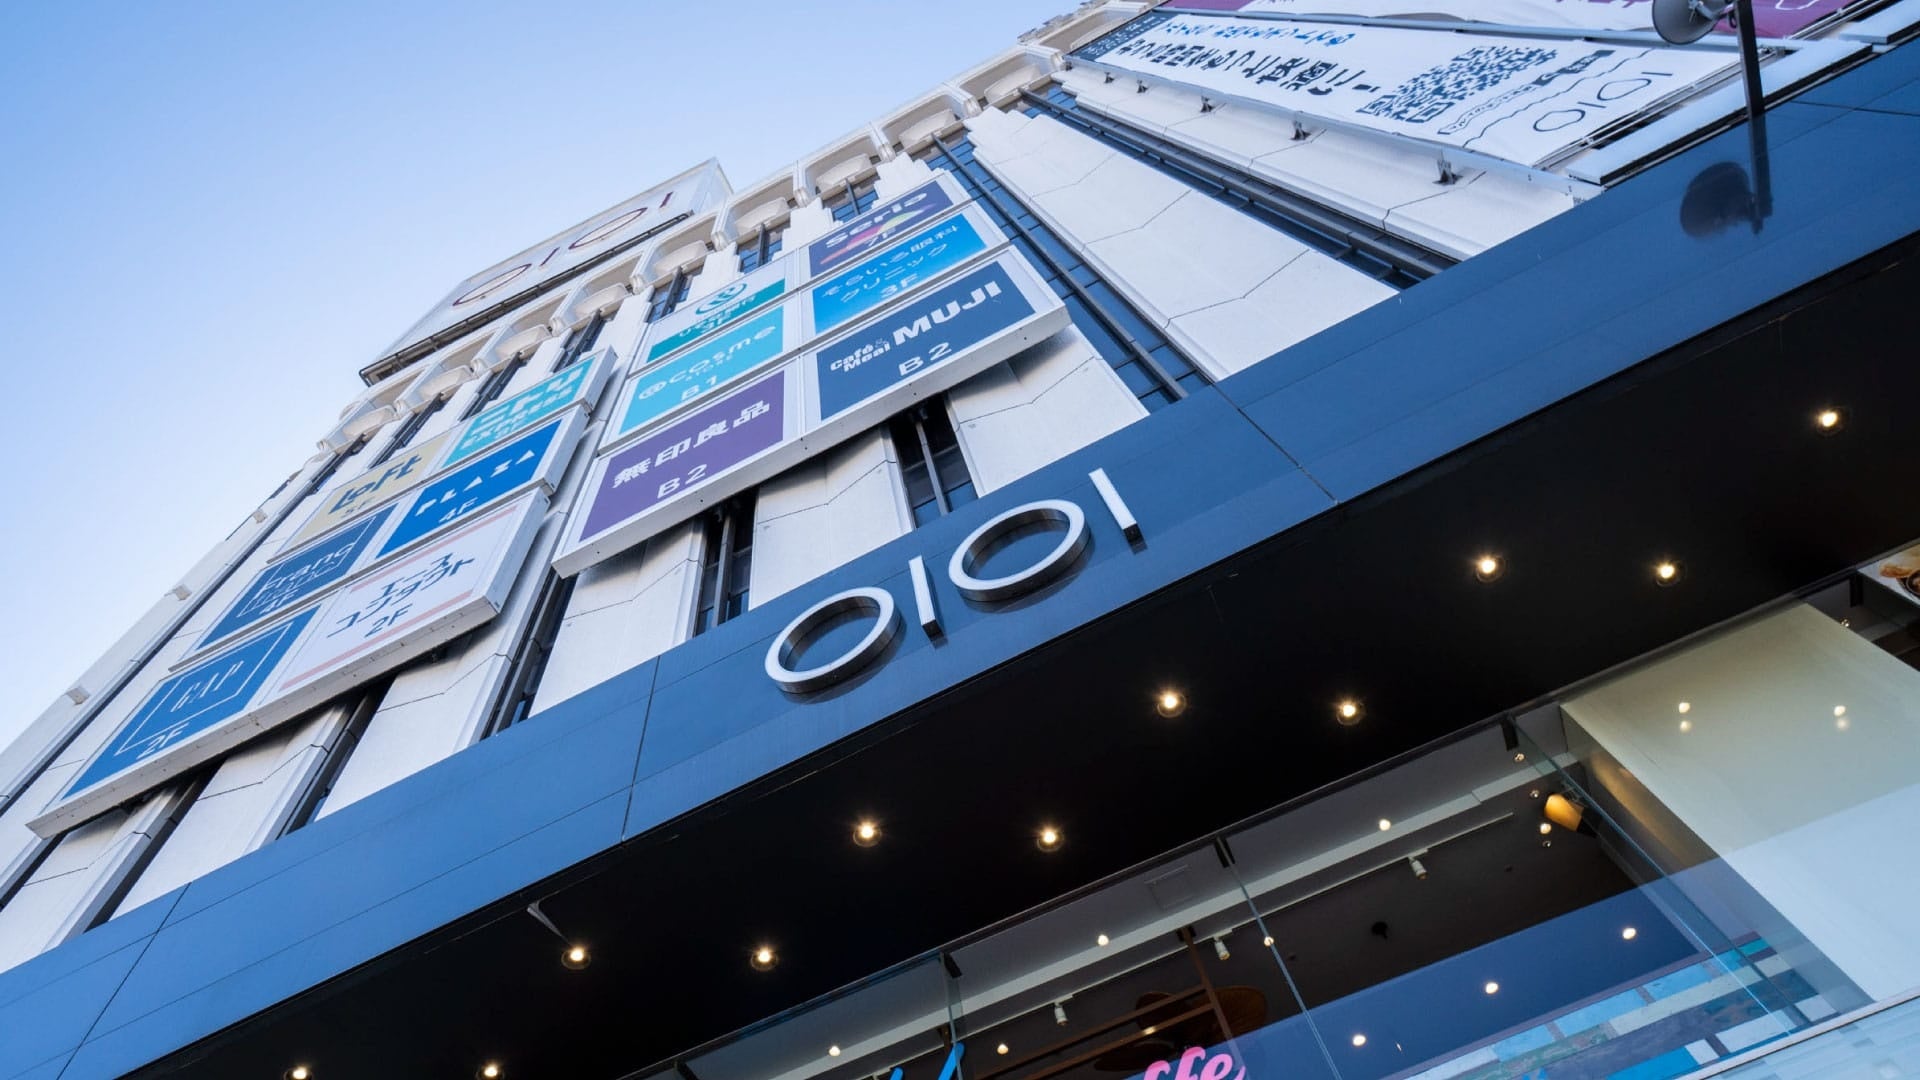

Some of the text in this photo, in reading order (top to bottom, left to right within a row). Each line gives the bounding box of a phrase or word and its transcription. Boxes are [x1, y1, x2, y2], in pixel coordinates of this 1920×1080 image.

[826, 192, 928, 249] Seria
[822, 225, 960, 298] そらいろ眼科
[841, 243, 948, 303] クリニック
[880, 273, 919, 299] 3F
[892, 280, 1003, 346] MUJI
[638, 325, 777, 401] @cosme
[843, 343, 891, 373] Meal
[471, 366, 584, 436] ニトリ
[612, 400, 771, 489] 無印良品
[415, 449, 535, 517] PLAZA
[438, 496, 479, 524] 4F
[327, 557, 476, 638] コンタクト
[369, 552, 453, 604] エース
[364, 603, 413, 638] 2F
[170, 660, 245, 713] GAP
[136, 722, 190, 760] 2F
